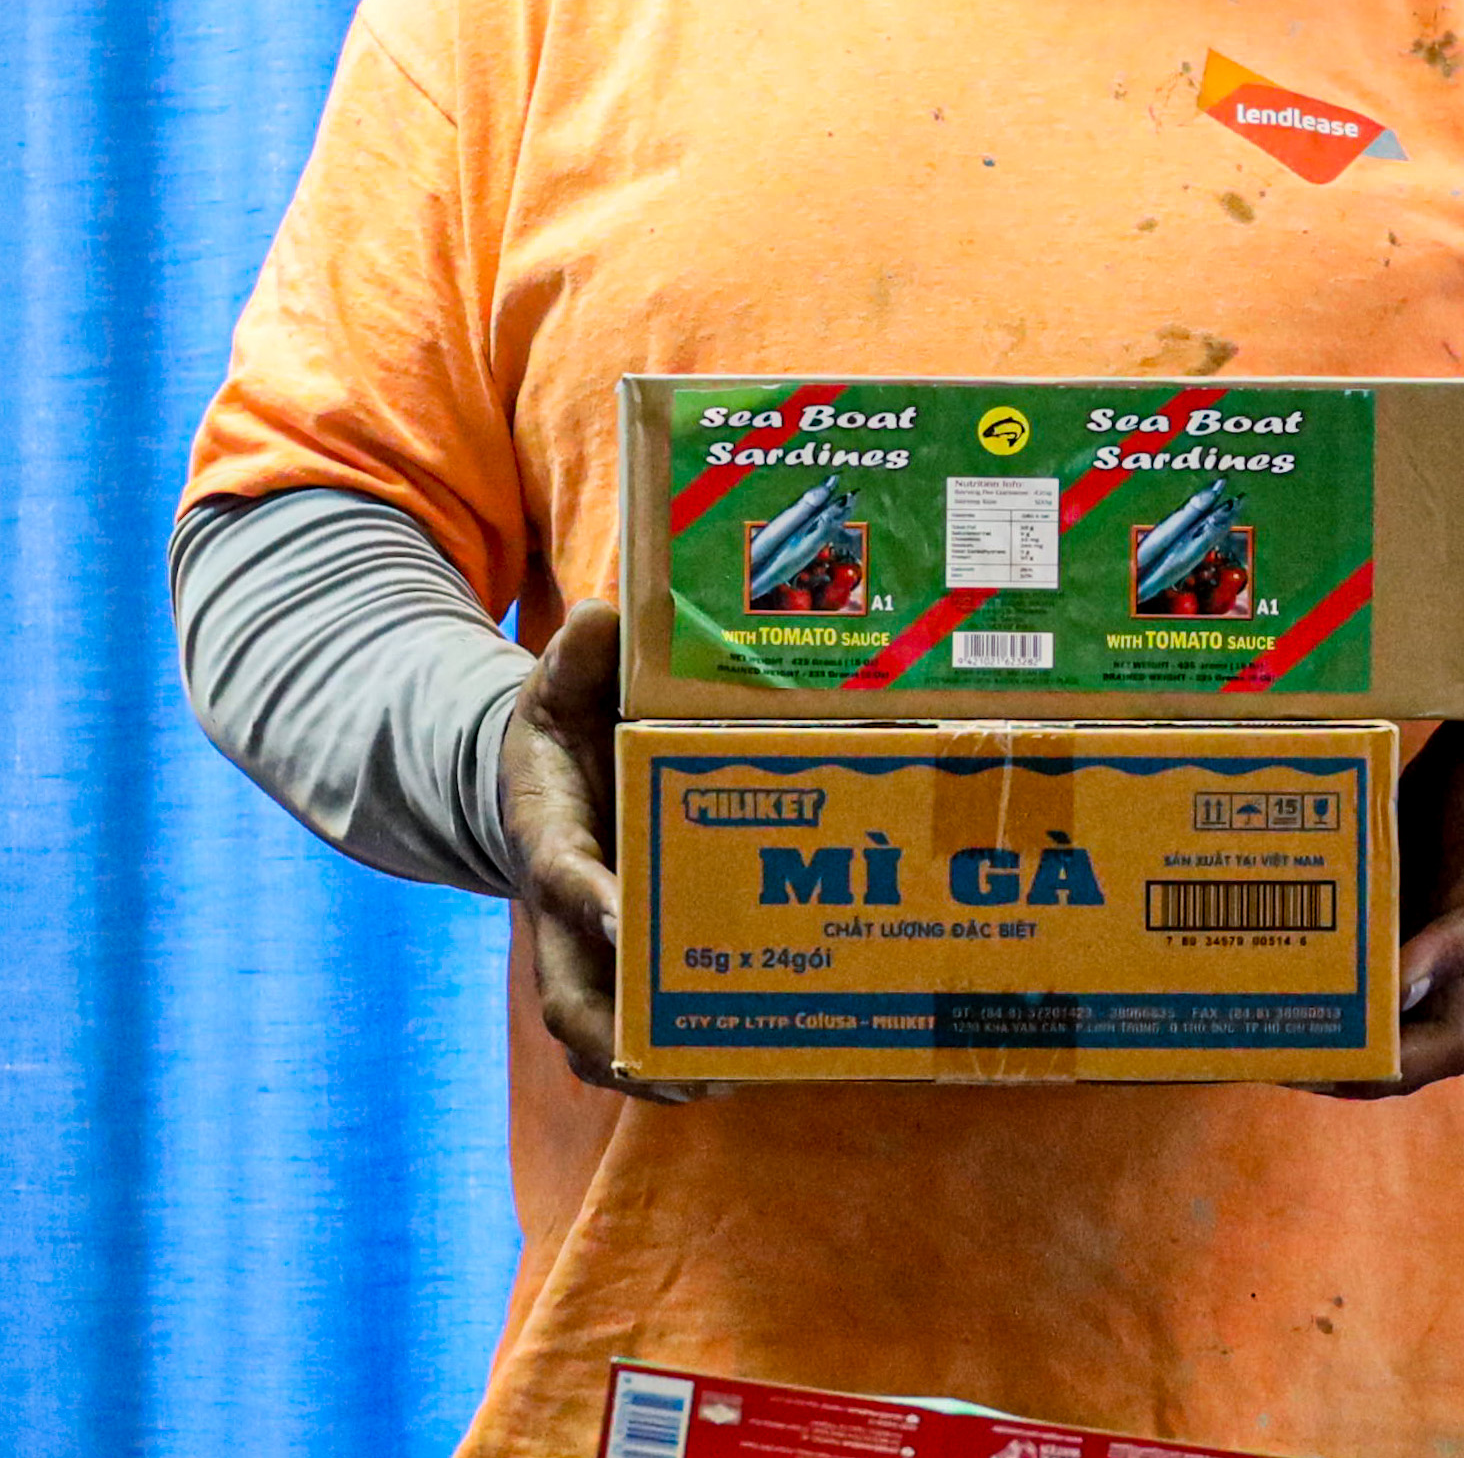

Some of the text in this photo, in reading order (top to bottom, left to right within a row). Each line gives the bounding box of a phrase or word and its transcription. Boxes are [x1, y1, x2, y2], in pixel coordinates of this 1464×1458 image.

[1236, 104, 1359, 137] lendlease
[700, 404, 918, 431] Sea Boat
[1086, 407, 1304, 436] Sea Boat
[705, 442, 911, 470] Sardines
[1092, 445, 1296, 474] Sardines
[871, 594, 894, 611] A1
[1256, 598, 1279, 616] A1
[722, 627, 890, 647] WITH TOMATO SAUCE
[1106, 631, 1276, 651] WITH TOMATO SAUCE
[686, 791, 820, 820] MILIKET
[1273, 798, 1299, 814] 15
[758, 830, 1105, 906] MÌ GÀ
[1166, 937, 1173, 946] 7
[685, 946, 832, 973] 65g x 24gói
[674, 1012, 936, 1031] CTY CP LTTP Colusa MILIKET
